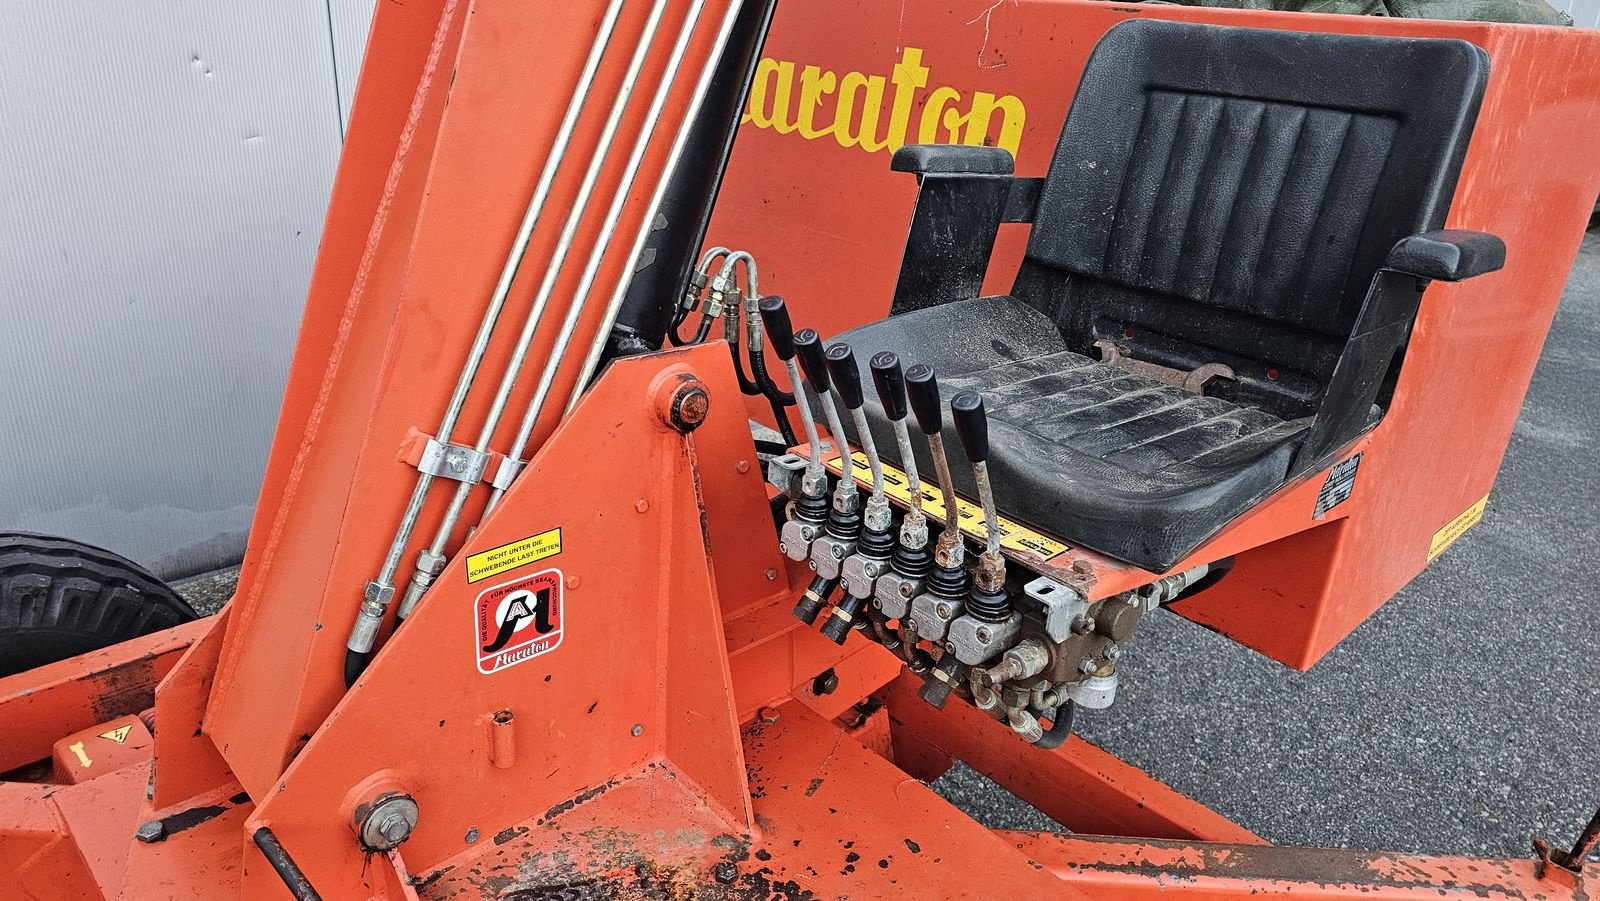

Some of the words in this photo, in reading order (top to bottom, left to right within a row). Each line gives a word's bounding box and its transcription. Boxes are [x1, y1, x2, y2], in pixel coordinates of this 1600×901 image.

[740, 47, 1027, 162] araton
[470, 557, 516, 576] SCHWEBENDE
[517, 550, 535, 561] LAST
[536, 542, 560, 555] TRETEN
[487, 550, 507, 562] NICHT
[509, 543, 531, 554] UNTER
[532, 539, 543, 547] DIE
[490, 590, 504, 600] FÜR
[504, 580, 535, 594] HÖCHSTE
[493, 641, 549, 669] Maraton
